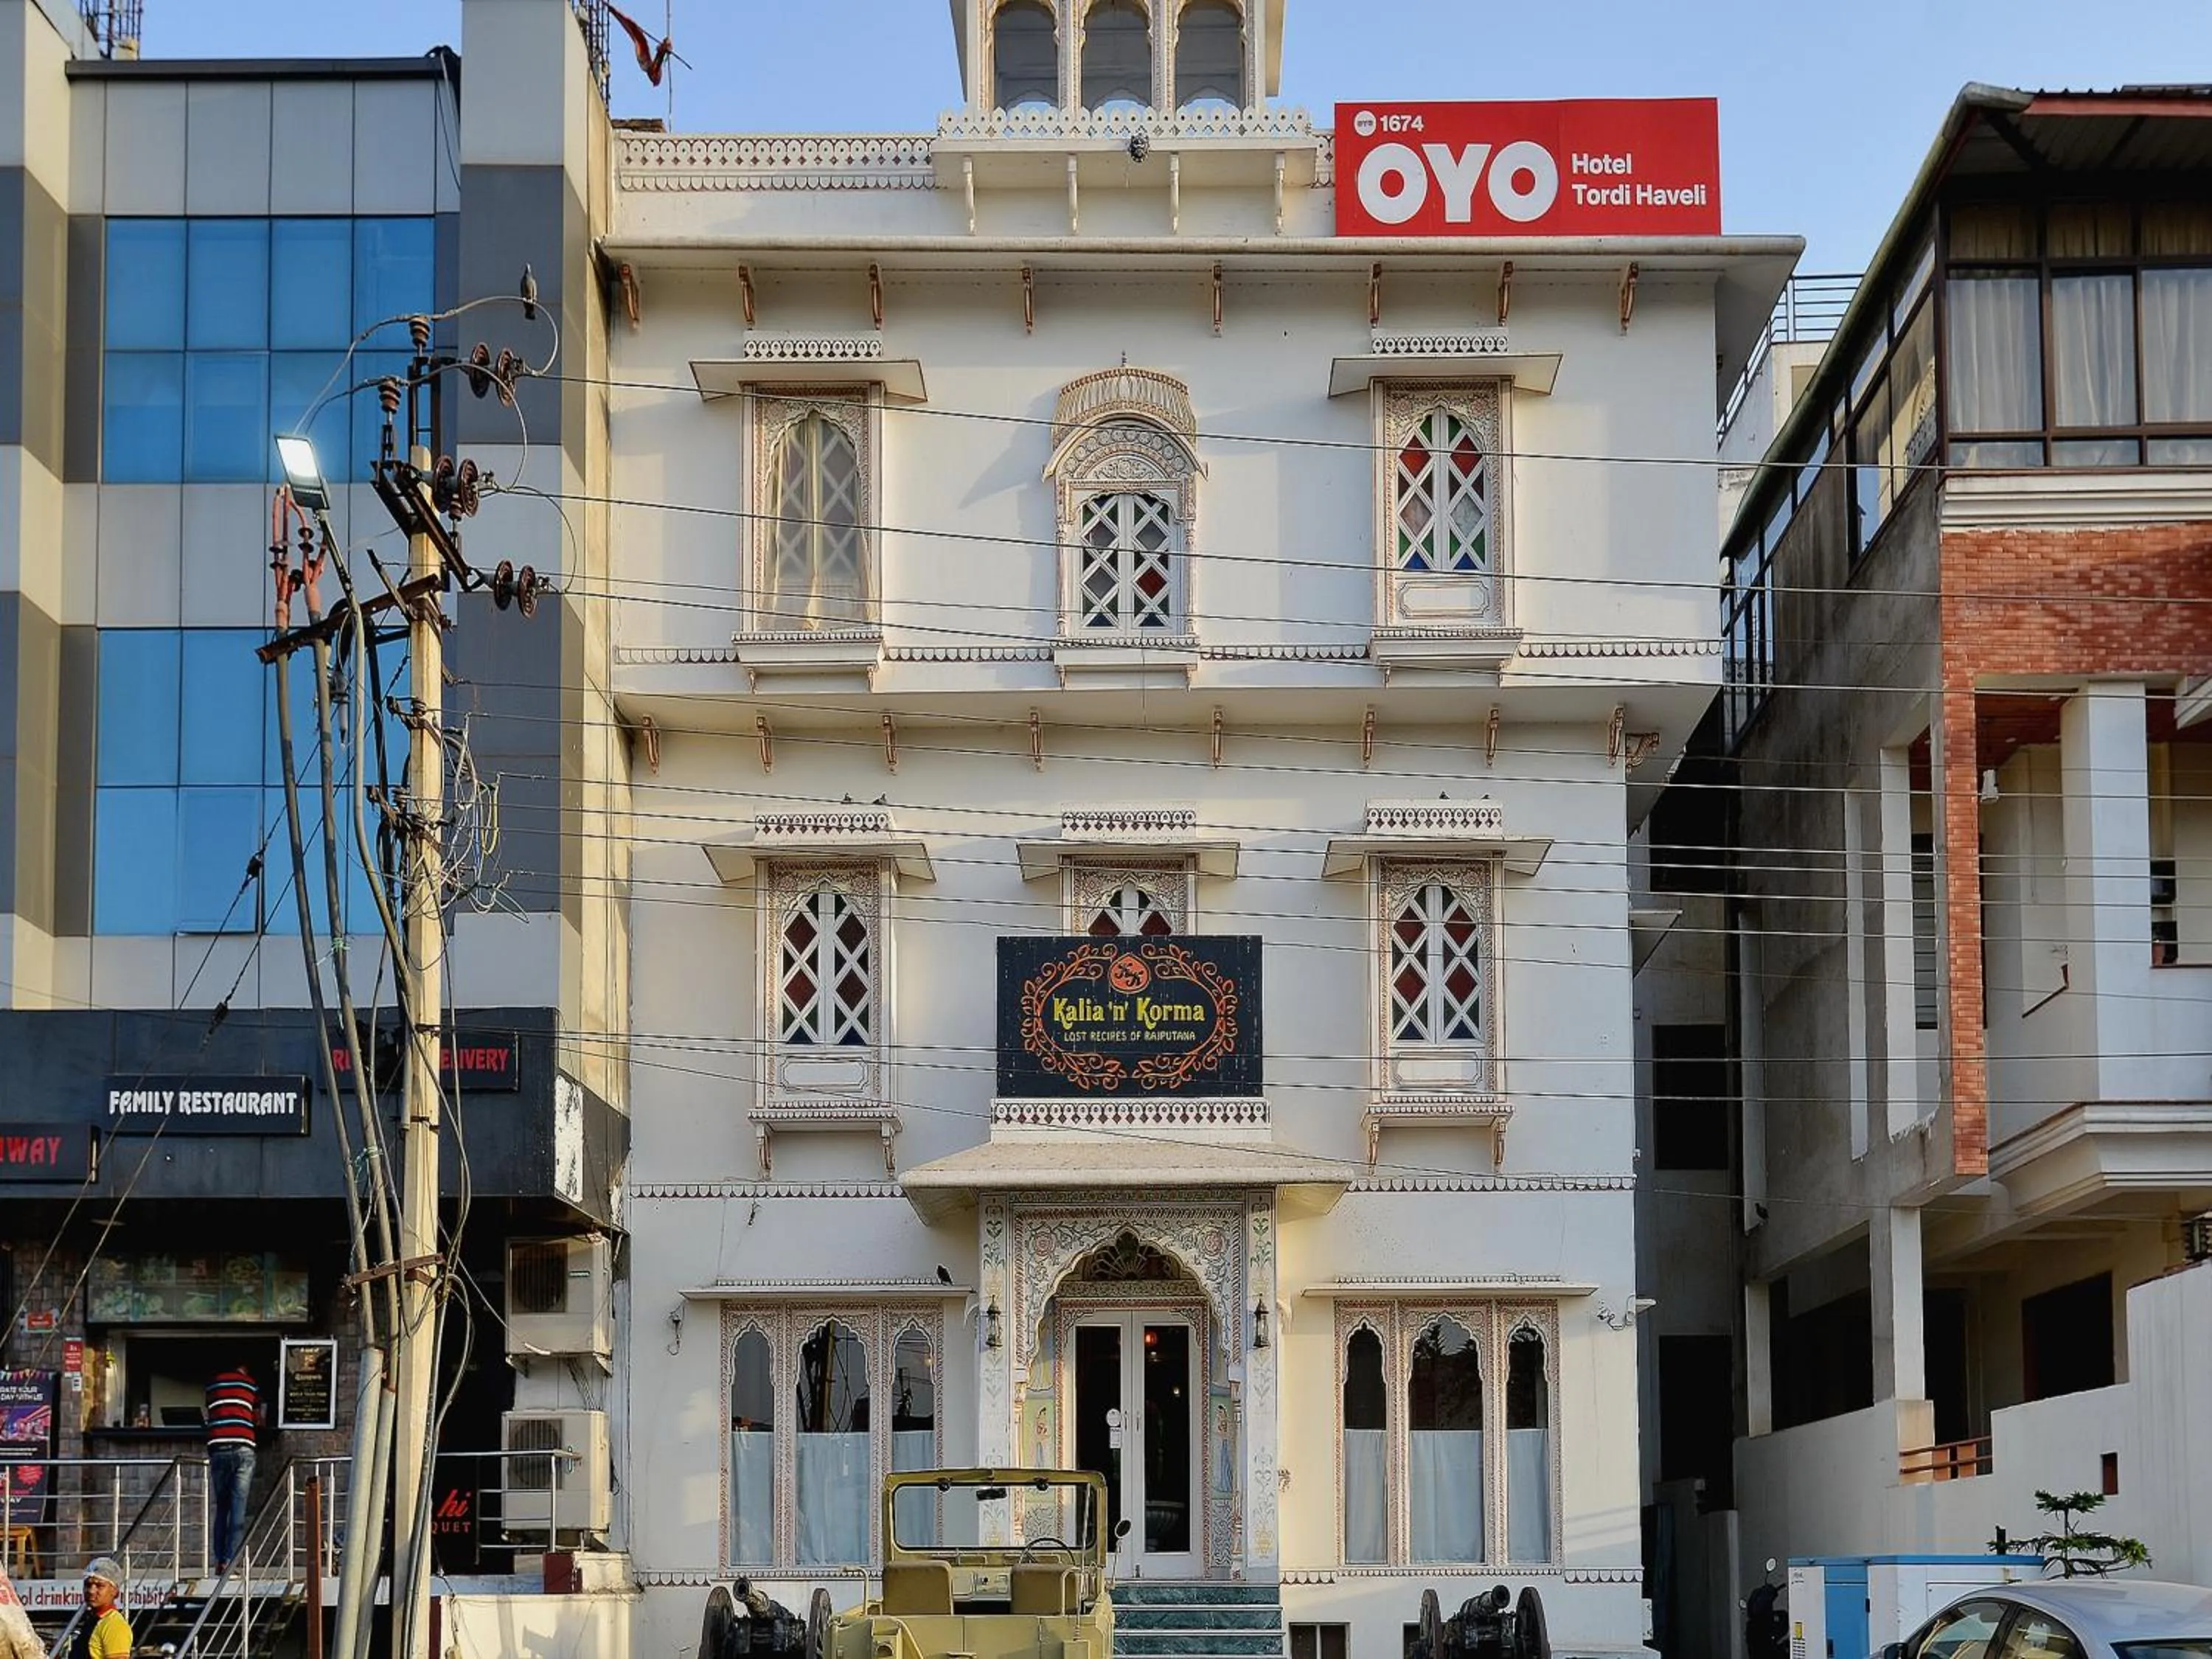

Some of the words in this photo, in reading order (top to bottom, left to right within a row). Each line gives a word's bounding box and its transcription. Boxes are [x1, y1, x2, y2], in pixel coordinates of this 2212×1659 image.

[1380, 114, 1425, 132] 1674
[1571, 153, 1632, 175] Hotel
[1356, 140, 1559, 224] OYO
[1571, 183, 1630, 206] Tordi
[1636, 183, 1708, 206] Haveli
[1052, 997, 1104, 1030] Kalia
[1136, 997, 1206, 1030] Korma
[1063, 1032, 1087, 1042] LOST
[1091, 1031, 1127, 1042] RECIPES
[1130, 1032, 1141, 1041] OF
[109, 1091, 175, 1116] FAMILY
[178, 1091, 298, 1116] RESTAURANT
[35, 1586, 83, 1605] drinkin
